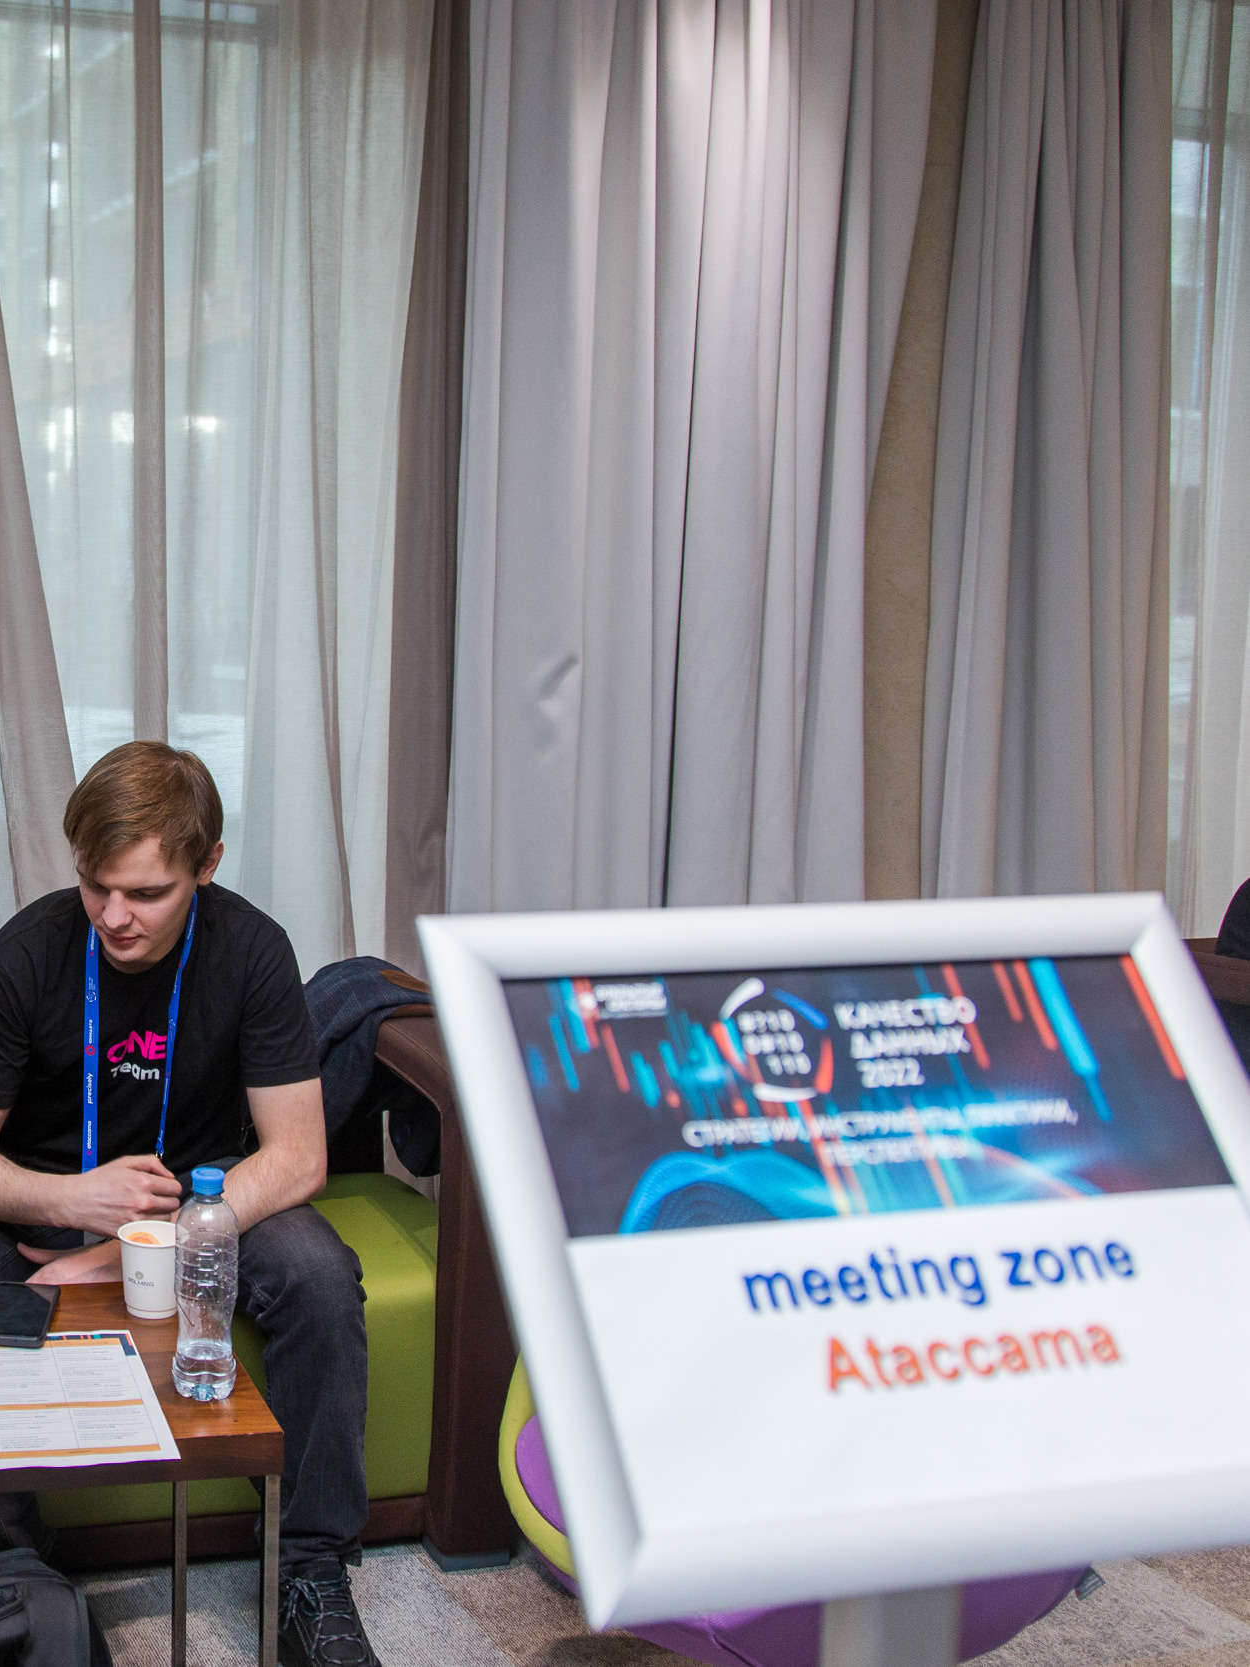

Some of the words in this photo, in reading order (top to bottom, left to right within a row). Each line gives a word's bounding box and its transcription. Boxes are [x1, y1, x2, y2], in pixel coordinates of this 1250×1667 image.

[834, 996, 977, 1030] КАЧЕСТВО
[106, 1030, 167, 1064] ONE
[856, 1057, 926, 1088] 2022
[742, 1247, 988, 1312] meeting
[999, 1238, 1136, 1288] zone
[826, 1325, 1121, 1392] Ataccama
